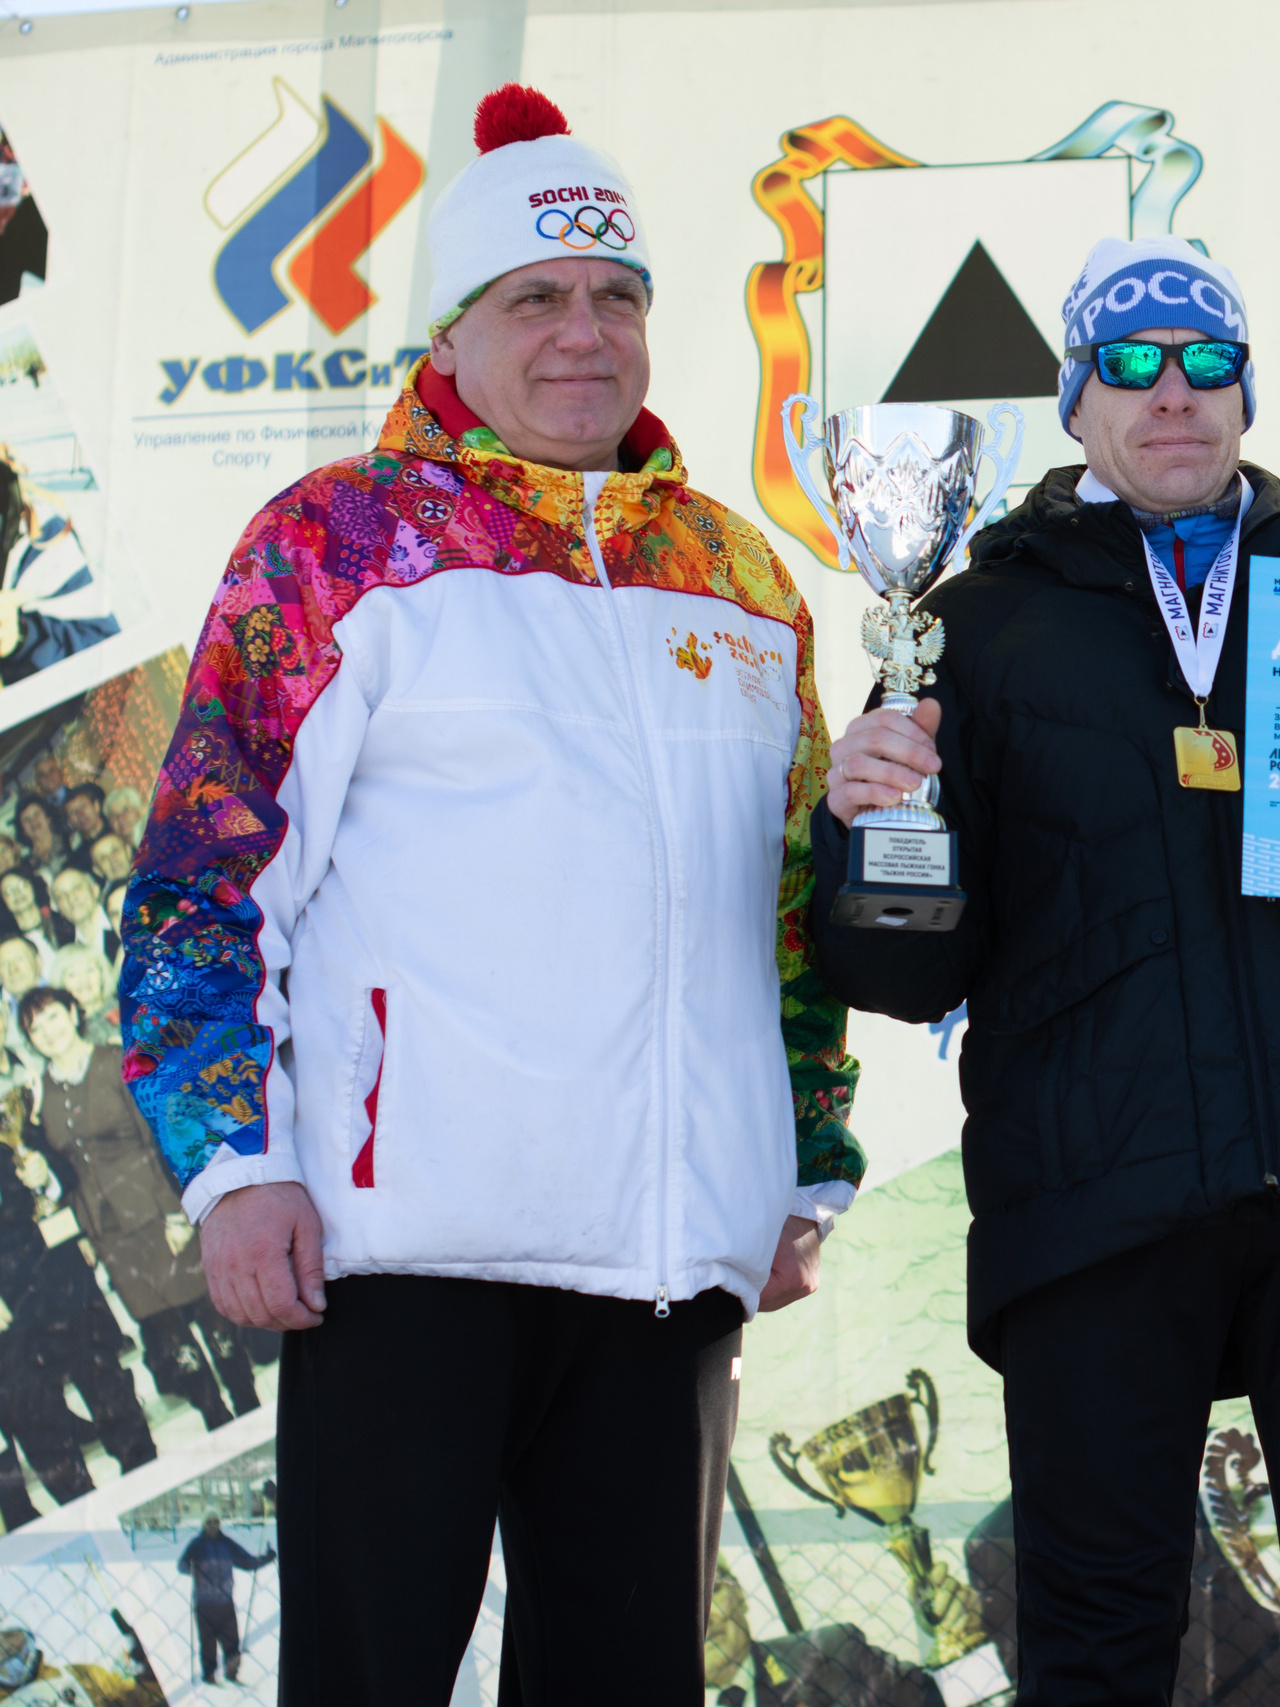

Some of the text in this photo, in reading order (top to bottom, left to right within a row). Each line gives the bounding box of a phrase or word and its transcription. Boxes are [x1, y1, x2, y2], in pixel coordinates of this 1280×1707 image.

[282, 39, 334, 56] города
[528, 186, 628, 208] SOCHI 2014
[132, 428, 231, 450] Управление
[236, 428, 256, 442] по
[260, 421, 357, 441] Физической
[211, 450, 272, 468] Спорту
[1274, 723, 1280, 731] В
